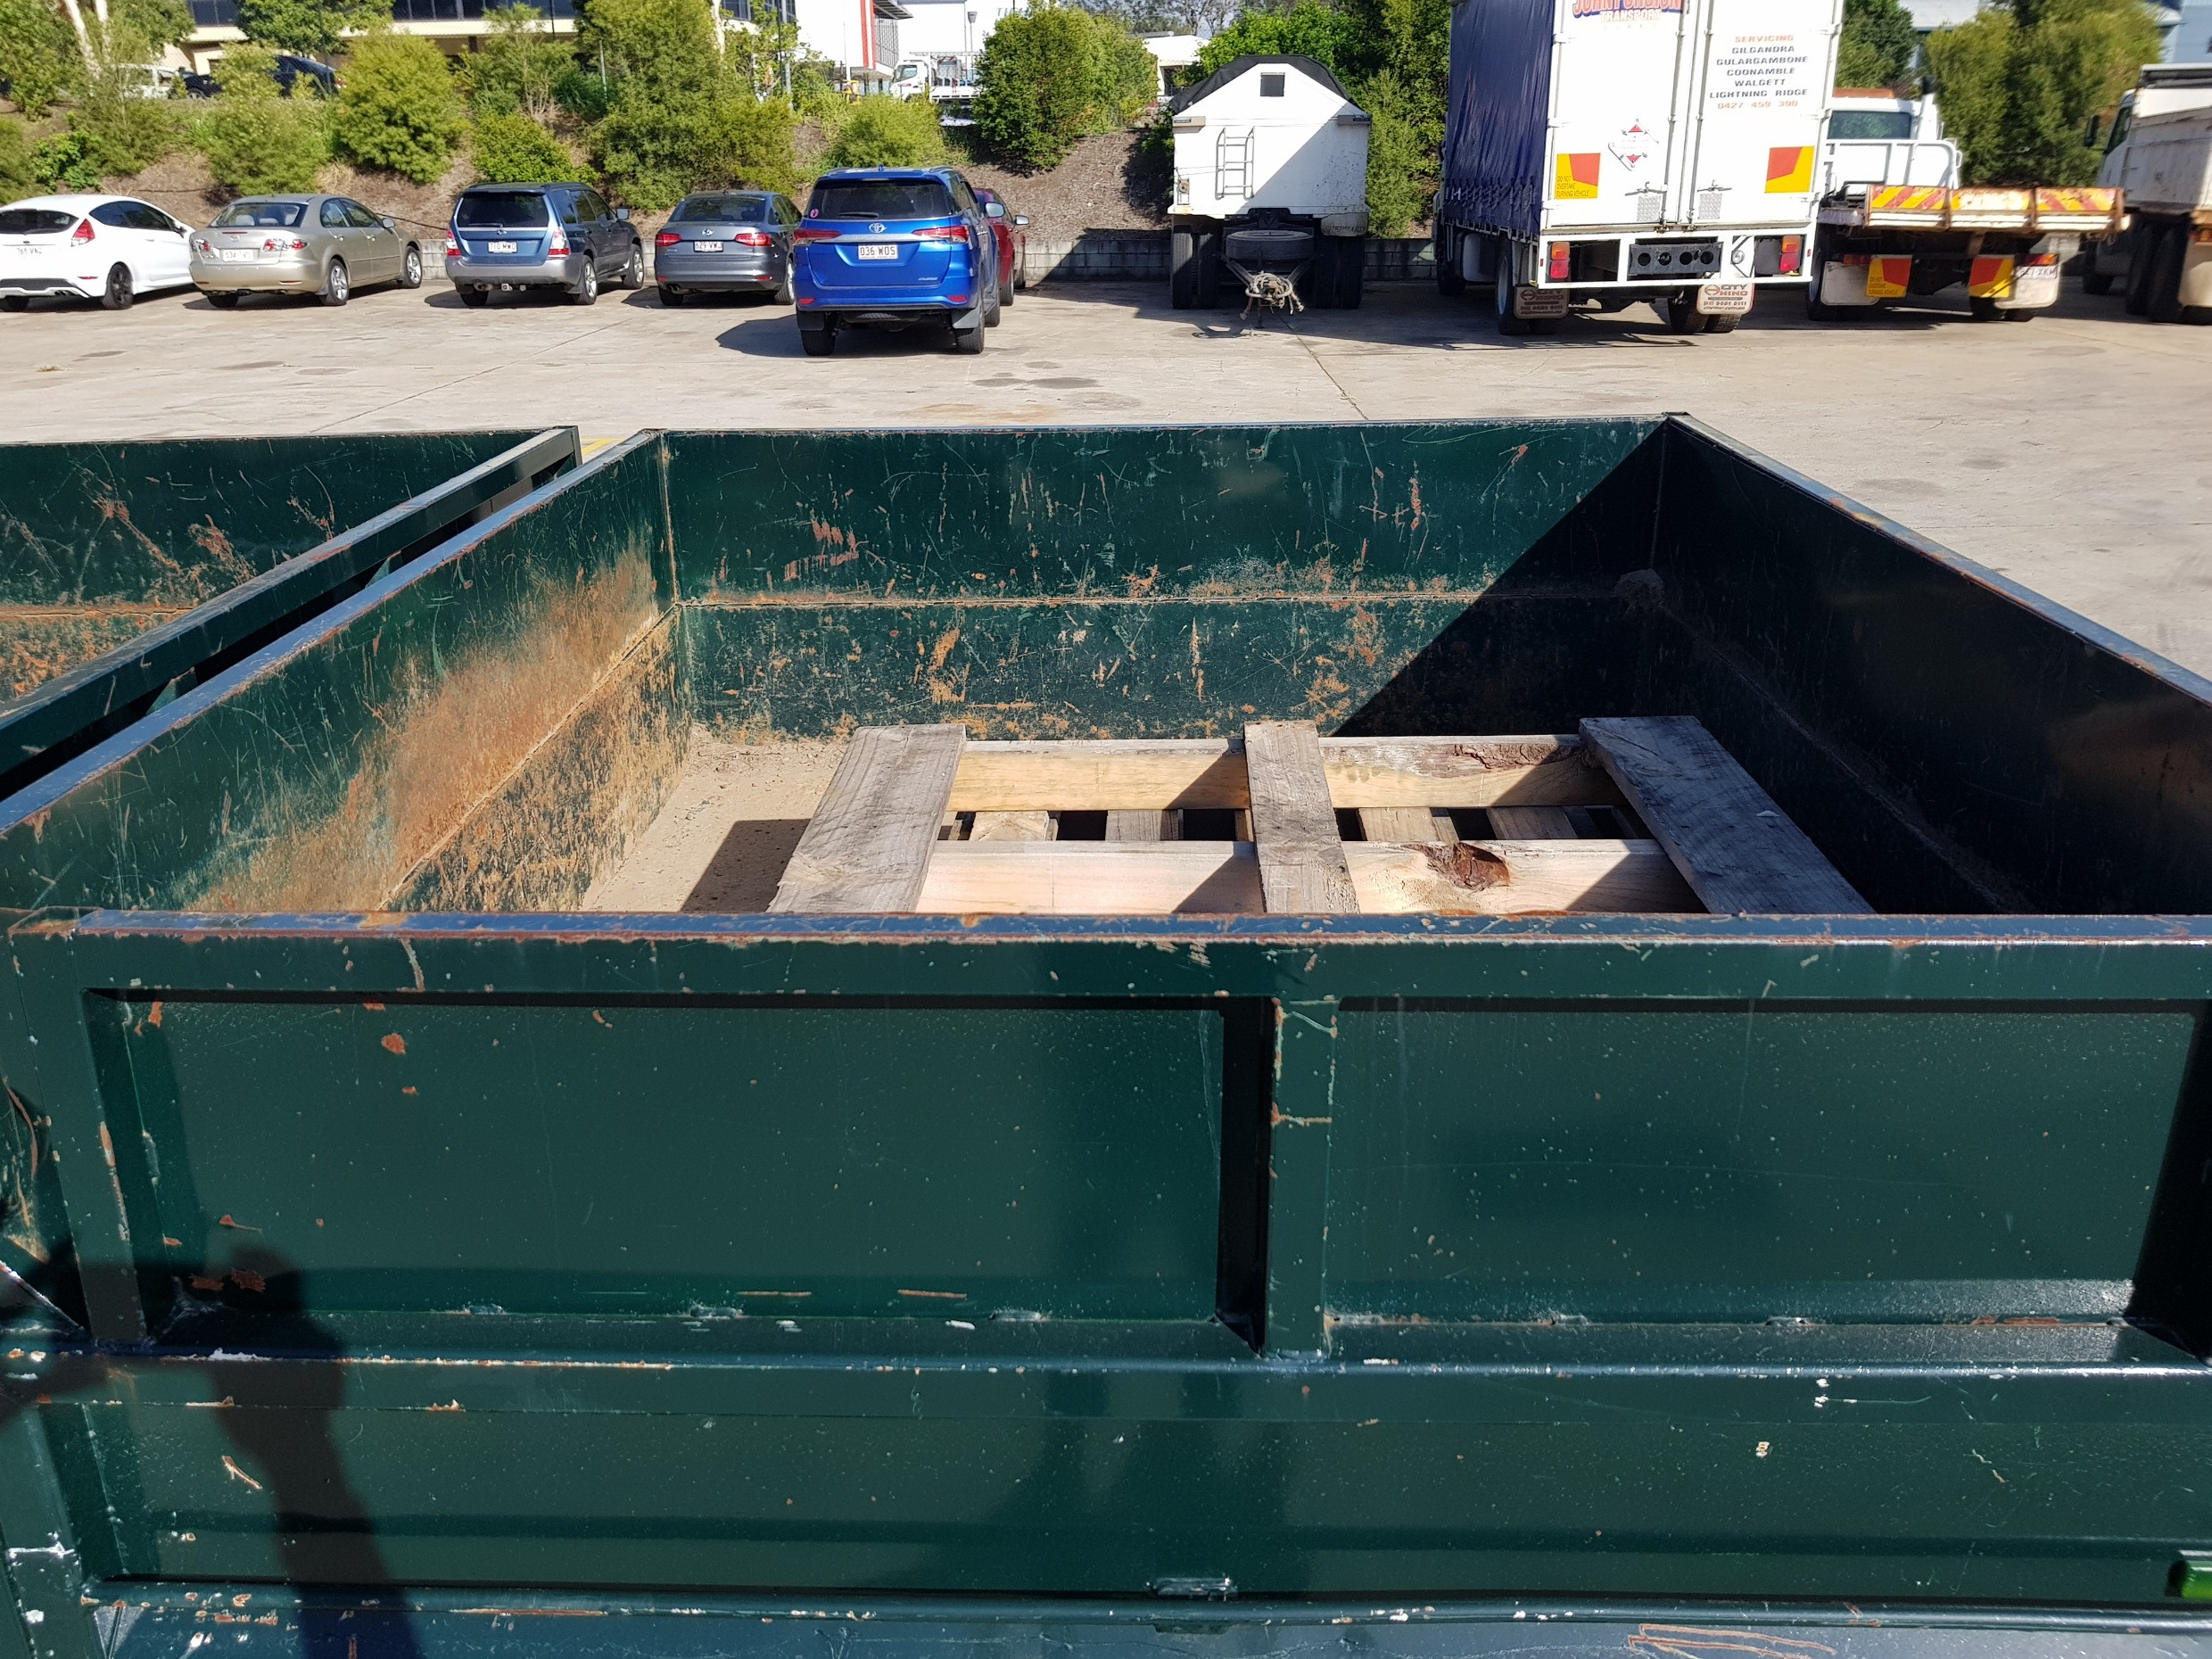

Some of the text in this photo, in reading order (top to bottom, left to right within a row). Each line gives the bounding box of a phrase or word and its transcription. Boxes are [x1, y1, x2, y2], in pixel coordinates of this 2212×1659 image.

[1600, 9, 1661, 21] TRANSPORT
[1735, 35, 1794, 43] SERVICING
[1732, 45, 1795, 54] GILGANDRA
[1716, 56, 1808, 65] GULARGAMBONE
[1727, 68, 1795, 76] COONAMBLE
[1735, 78, 1786, 87] WALGETT
[1710, 88, 1808, 98] LIGHTNING RIDGE
[860, 246, 896, 256] 036 WOS
